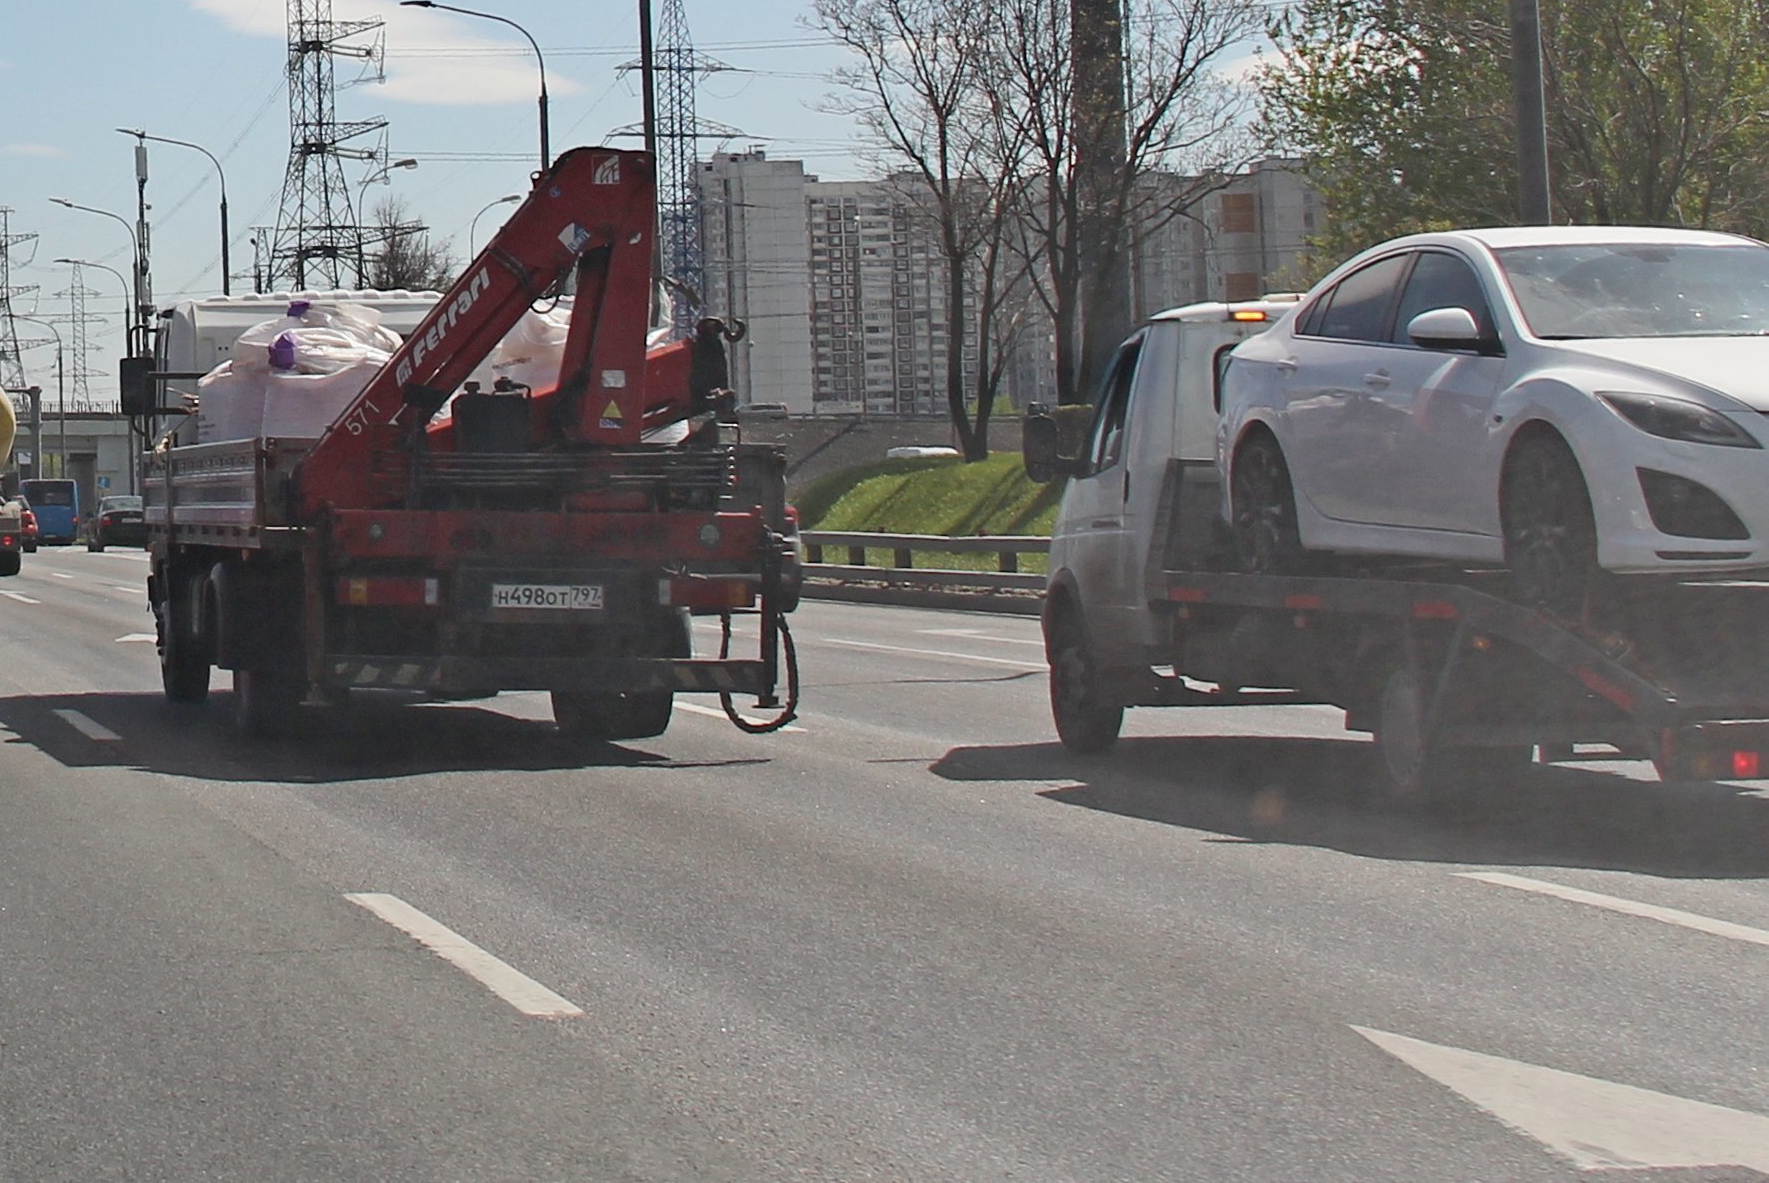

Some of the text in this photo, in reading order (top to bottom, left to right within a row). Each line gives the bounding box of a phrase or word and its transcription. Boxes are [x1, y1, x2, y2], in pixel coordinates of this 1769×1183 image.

[345, 400, 380, 435] 571
[498, 587, 599, 606] Н498ОТ 797
